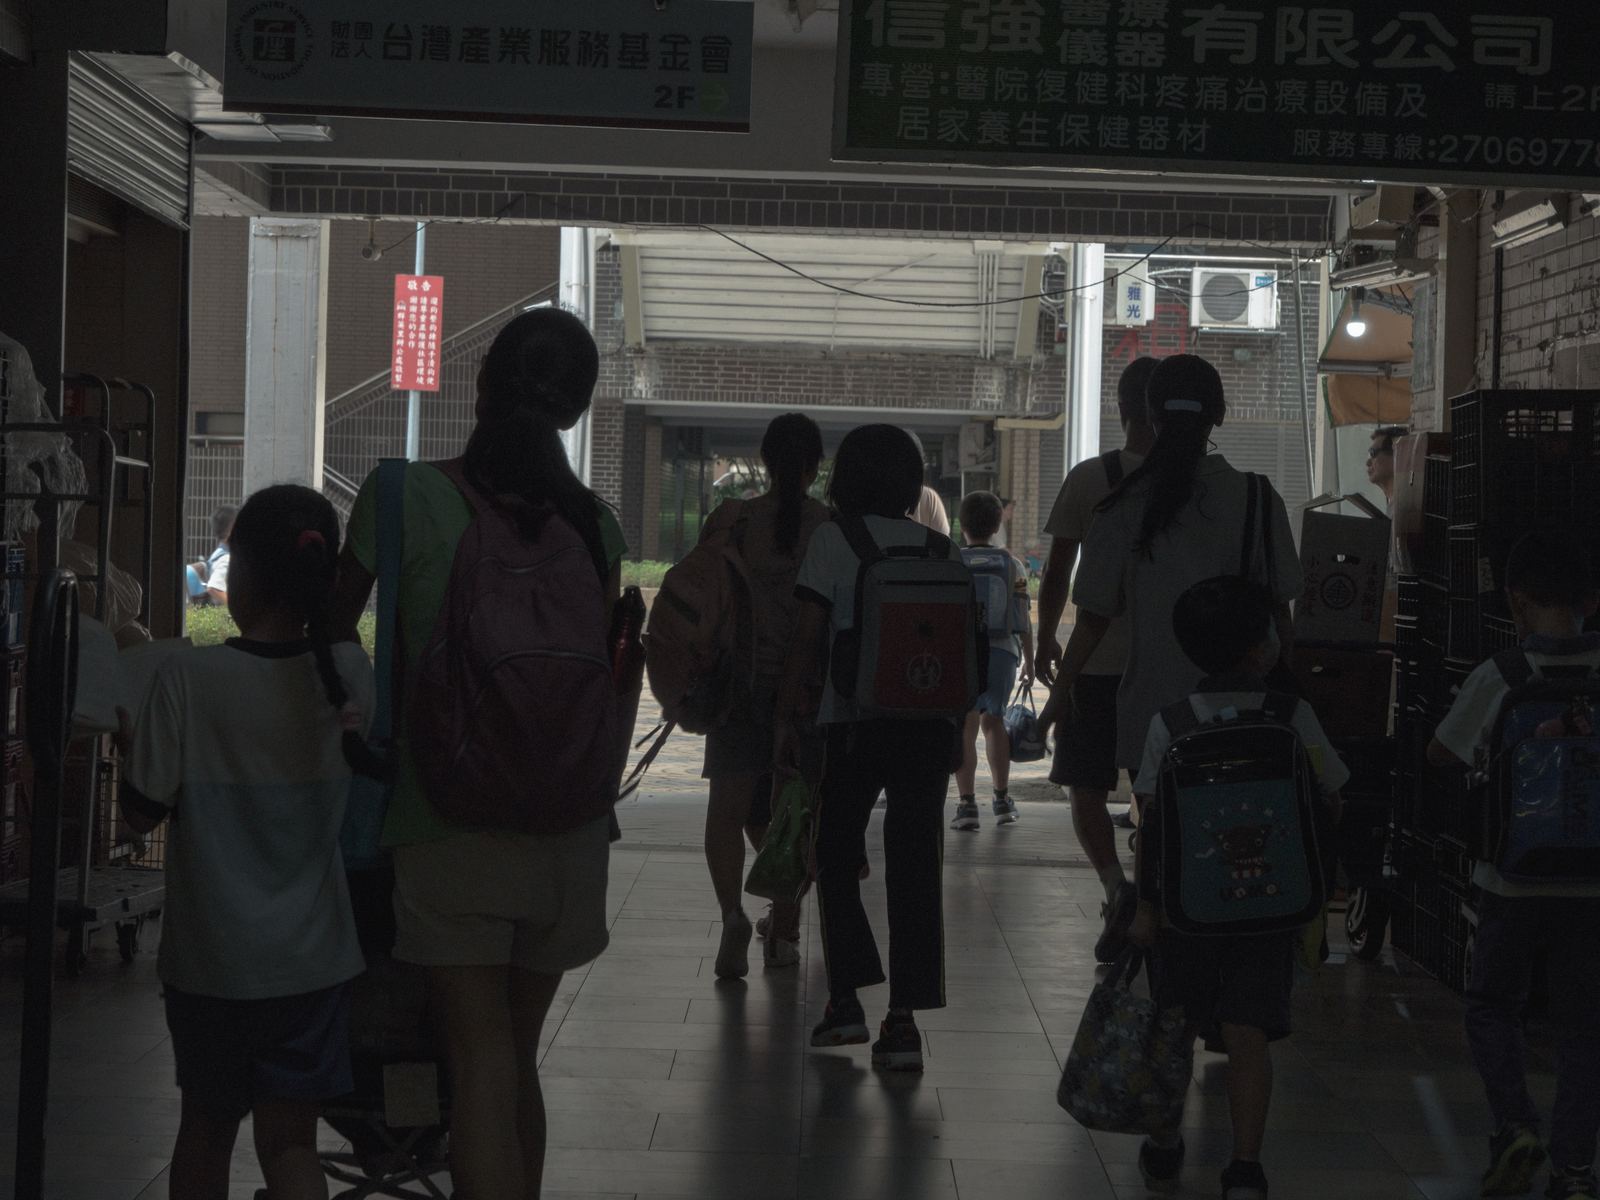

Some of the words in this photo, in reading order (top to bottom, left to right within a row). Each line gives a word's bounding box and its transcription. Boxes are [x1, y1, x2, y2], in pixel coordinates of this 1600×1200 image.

[330, 20, 373, 41] 財團
[864, 0, 1044, 54] 信強
[1056, 29, 1168, 67] 儀器
[1181, 4, 1553, 76] 有限公司
[330, 41, 373, 59] 法人
[382, 23, 733, 74] 台灣產業服務基金會
[654, 84, 695, 109] 2F
[898, 106, 1210, 152] 居家養生保健器材
[1292, 129, 1600, 167] 服務專線:2706977
[1126, 286, 1141, 318] 雅光
